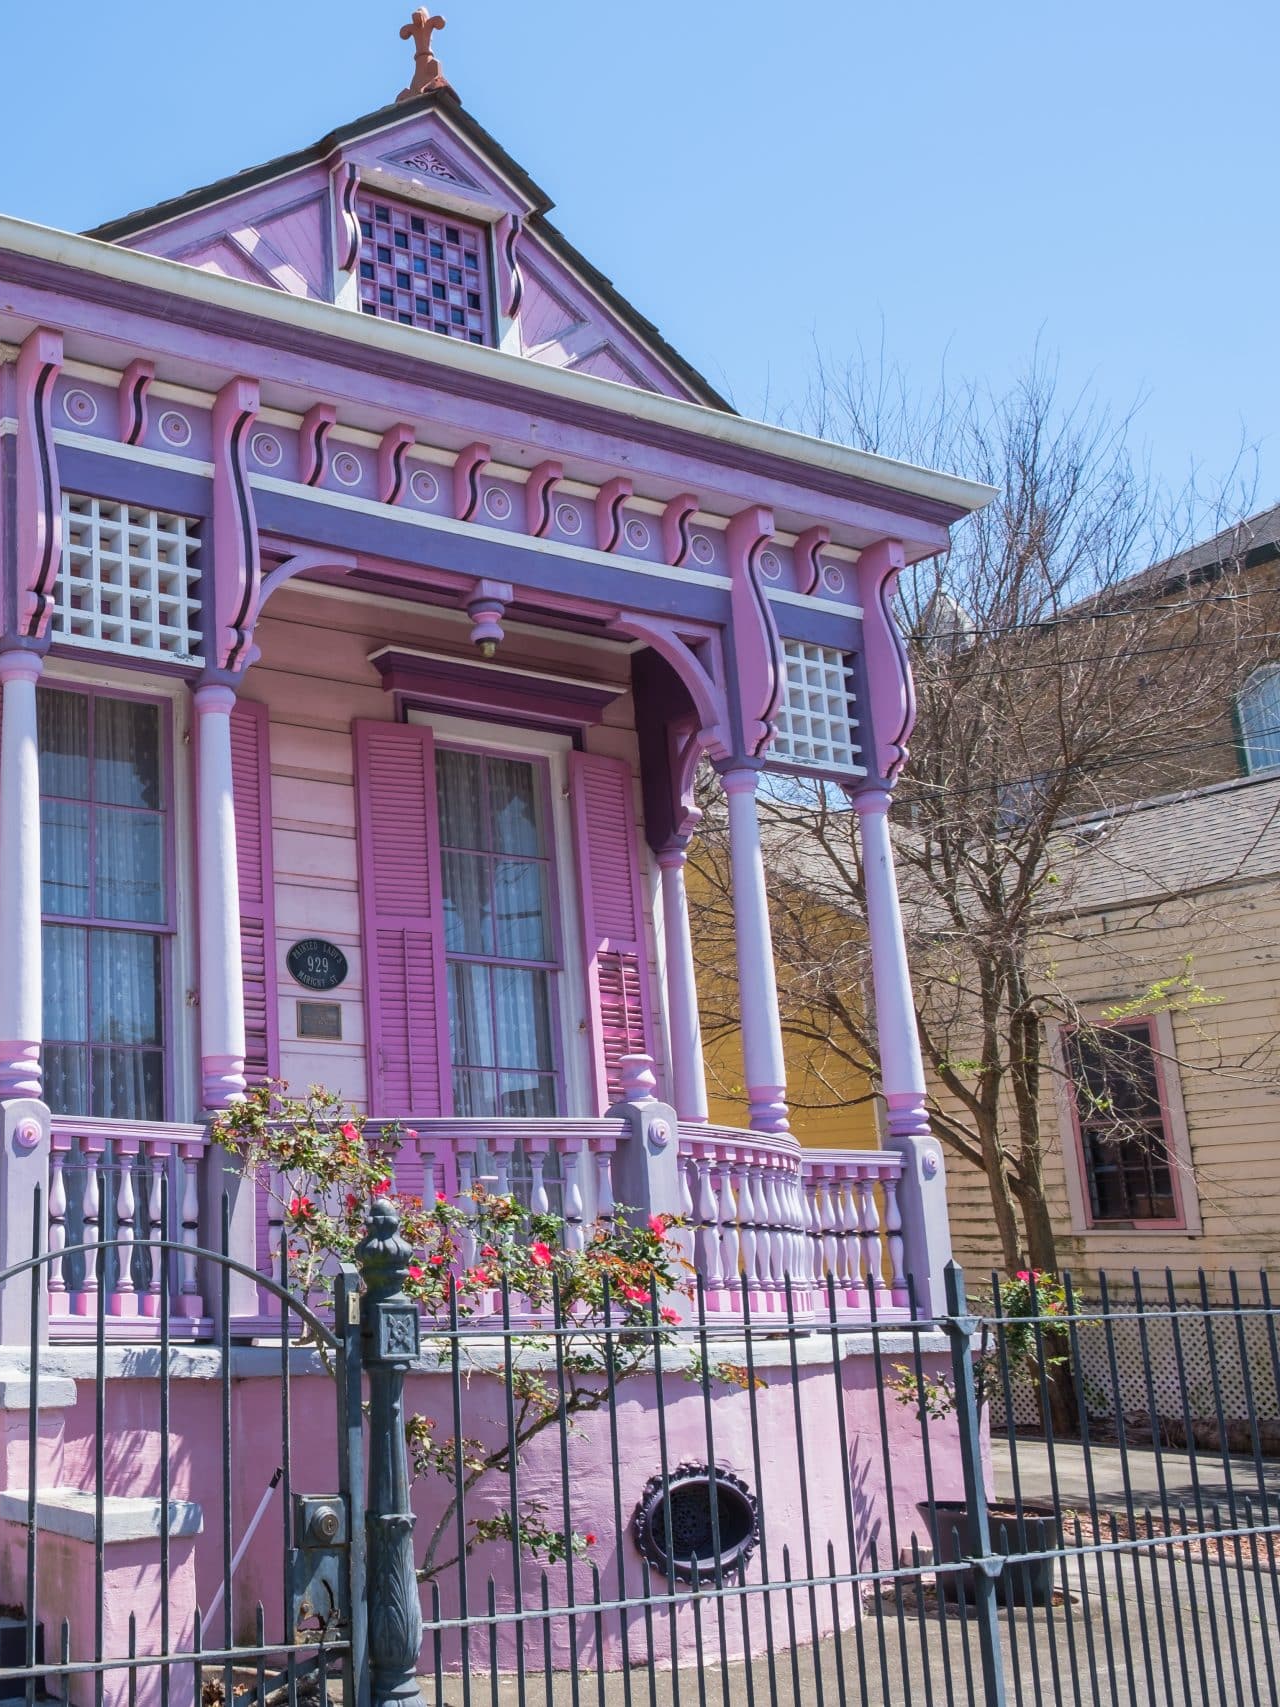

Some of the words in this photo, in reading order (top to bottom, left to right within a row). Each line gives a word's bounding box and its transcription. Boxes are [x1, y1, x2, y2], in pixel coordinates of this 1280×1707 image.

[292, 941, 318, 959] PAINTED
[307, 955, 329, 973] 929
[297, 970, 325, 987] MARIGNY
